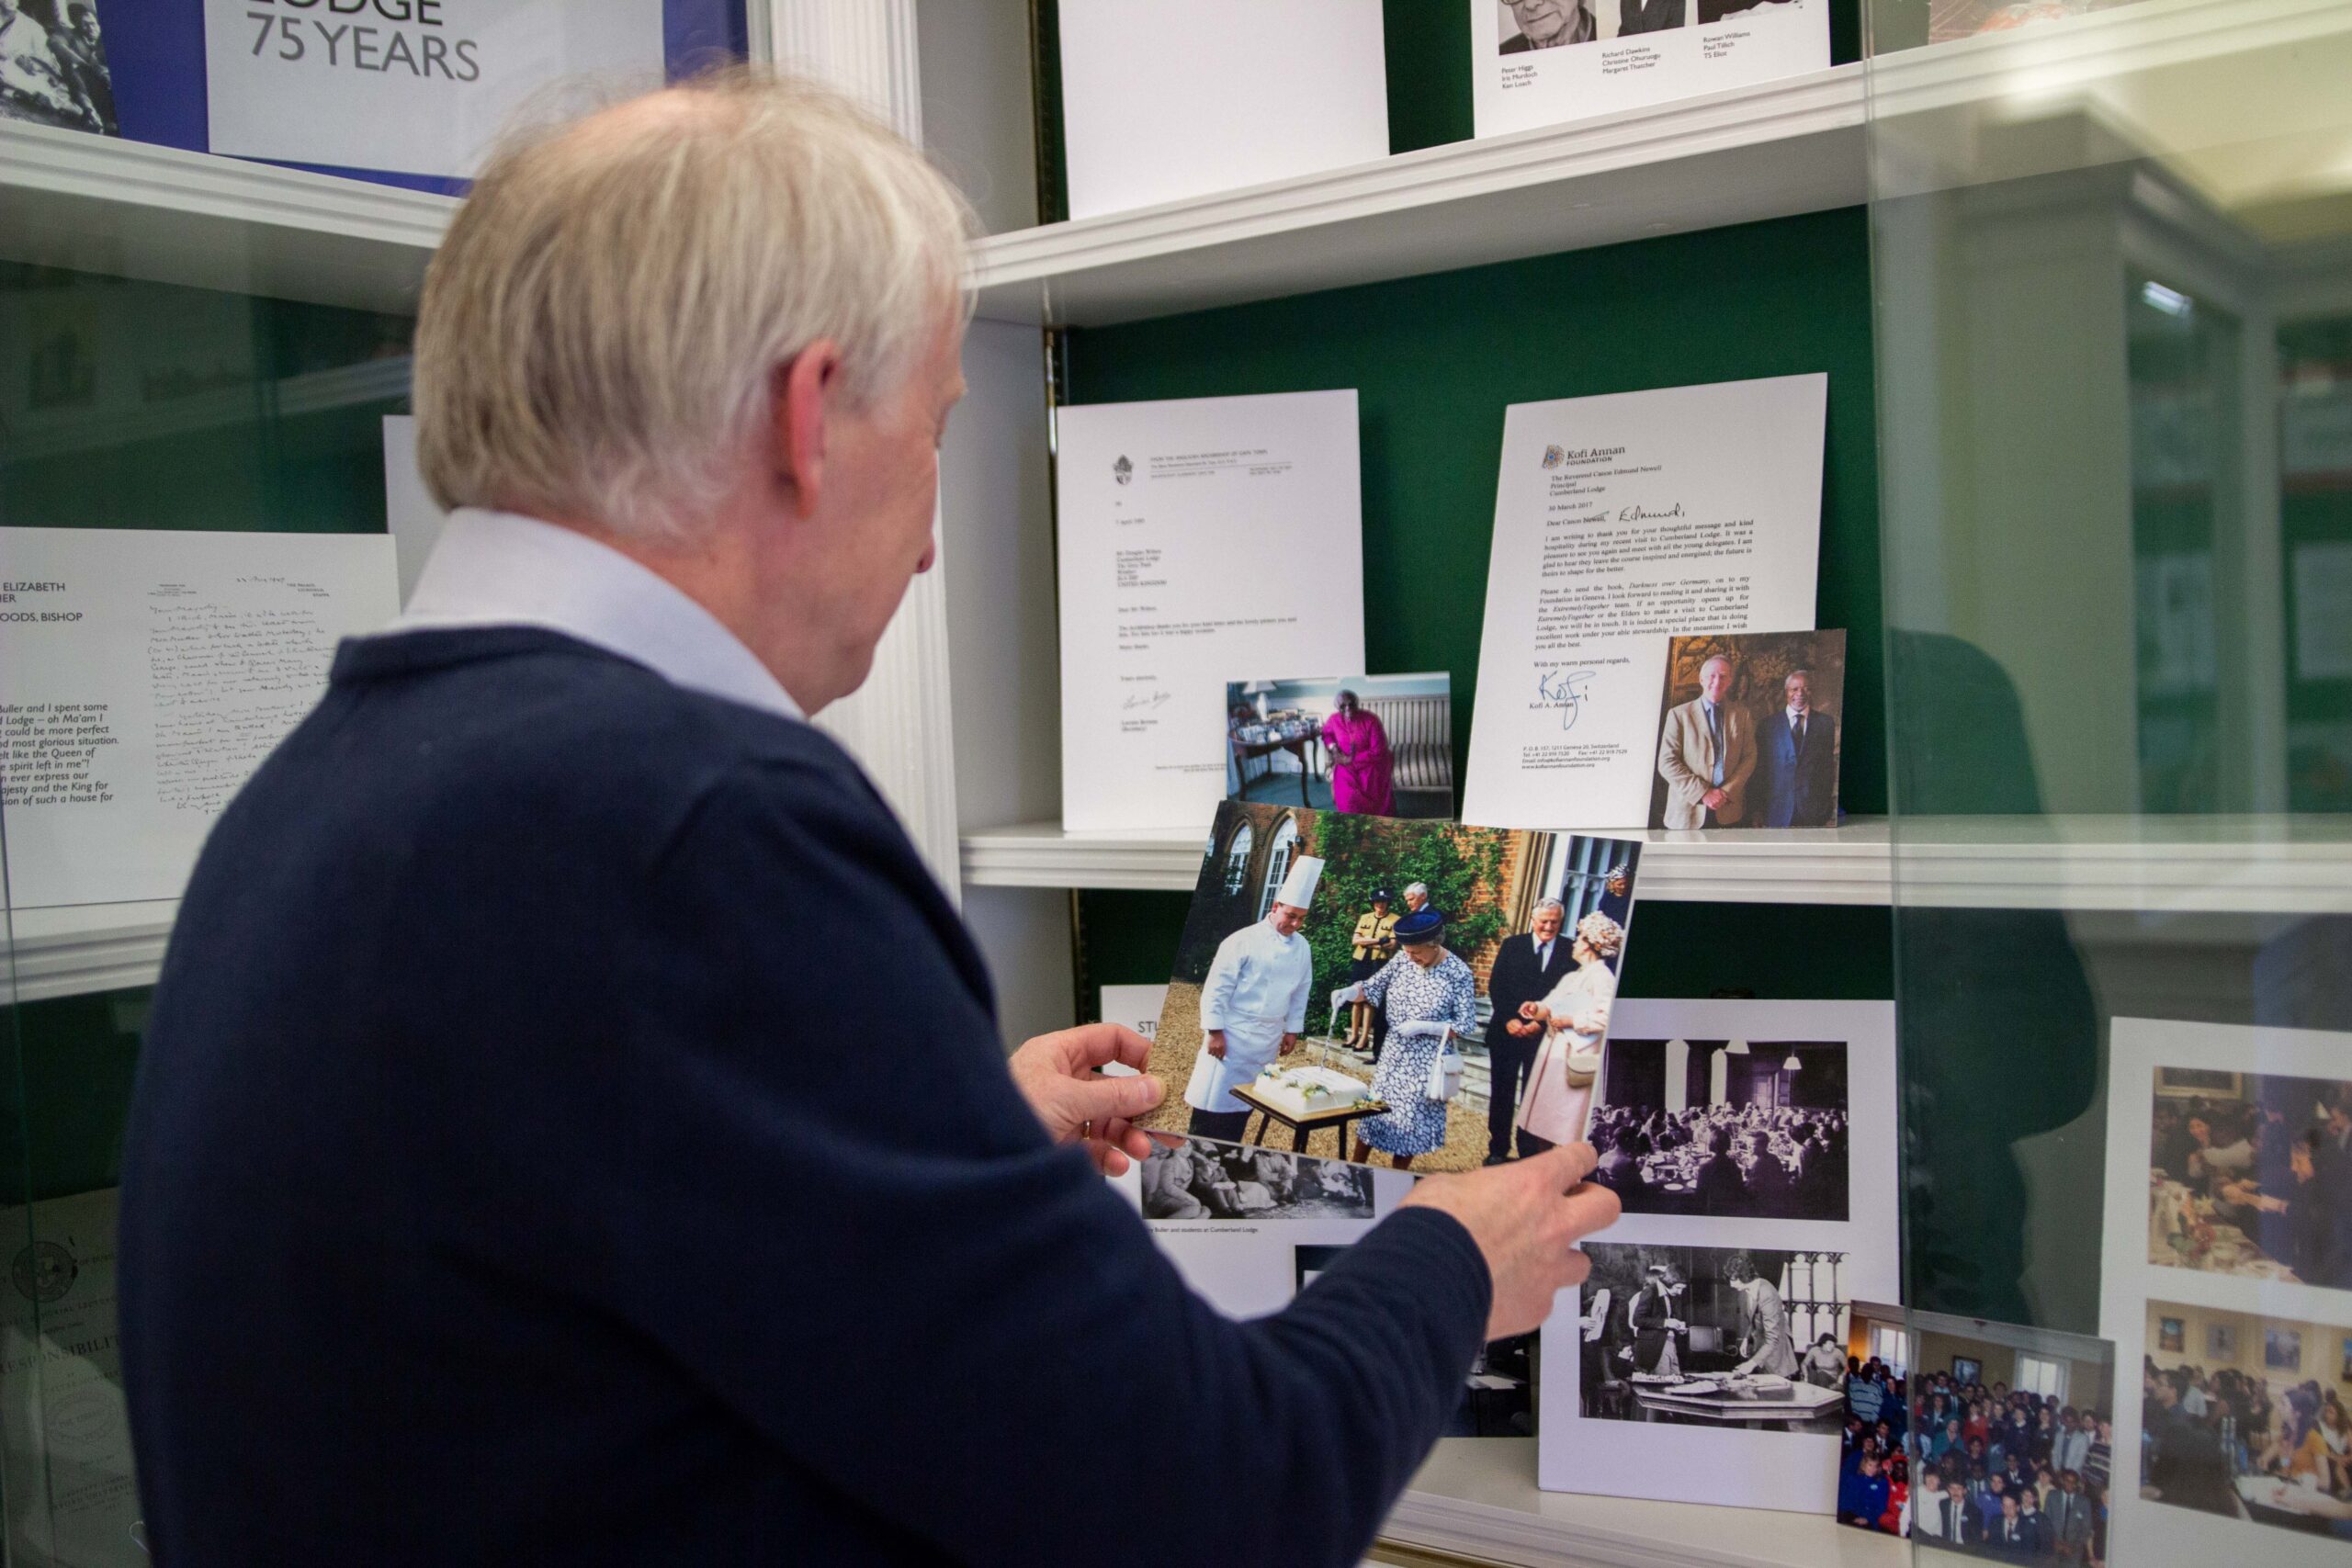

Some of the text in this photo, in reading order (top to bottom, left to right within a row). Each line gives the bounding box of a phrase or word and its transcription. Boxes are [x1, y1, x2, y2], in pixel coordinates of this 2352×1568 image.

[247, 11, 480, 82] 75 YEARS
[1566, 446, 1625, 459] Kofi Annan
[1566, 457, 1612, 466] FOUNDATION
[3, 582, 65, 592] ELIZABETH
[0, 613, 83, 622] OODS, BISHOP
[27, 704, 44, 712] and
[55, 704, 80, 713] spent
[6, 716, 34, 727] Lodge
[48, 716, 59, 724] oh
[100, 714, 102, 722] I
[6, 728, 30, 736] could
[76, 725, 108, 736] perfect
[39, 739, 74, 749] glorious
[13, 750, 28, 759] like
[33, 750, 47, 758] the
[51, 749, 82, 759] Queen
[85, 748, 96, 758] of
[10, 761, 33, 773] spirit
[37, 761, 52, 772] left
[55, 761, 62, 769] in
[34, 773, 69, 783] express
[2, 781, 108, 795] ajesty and the King for
[23, 795, 33, 806] of
[36, 795, 56, 804] such
[70, 794, 97, 802] house
[100, 793, 114, 803] for
